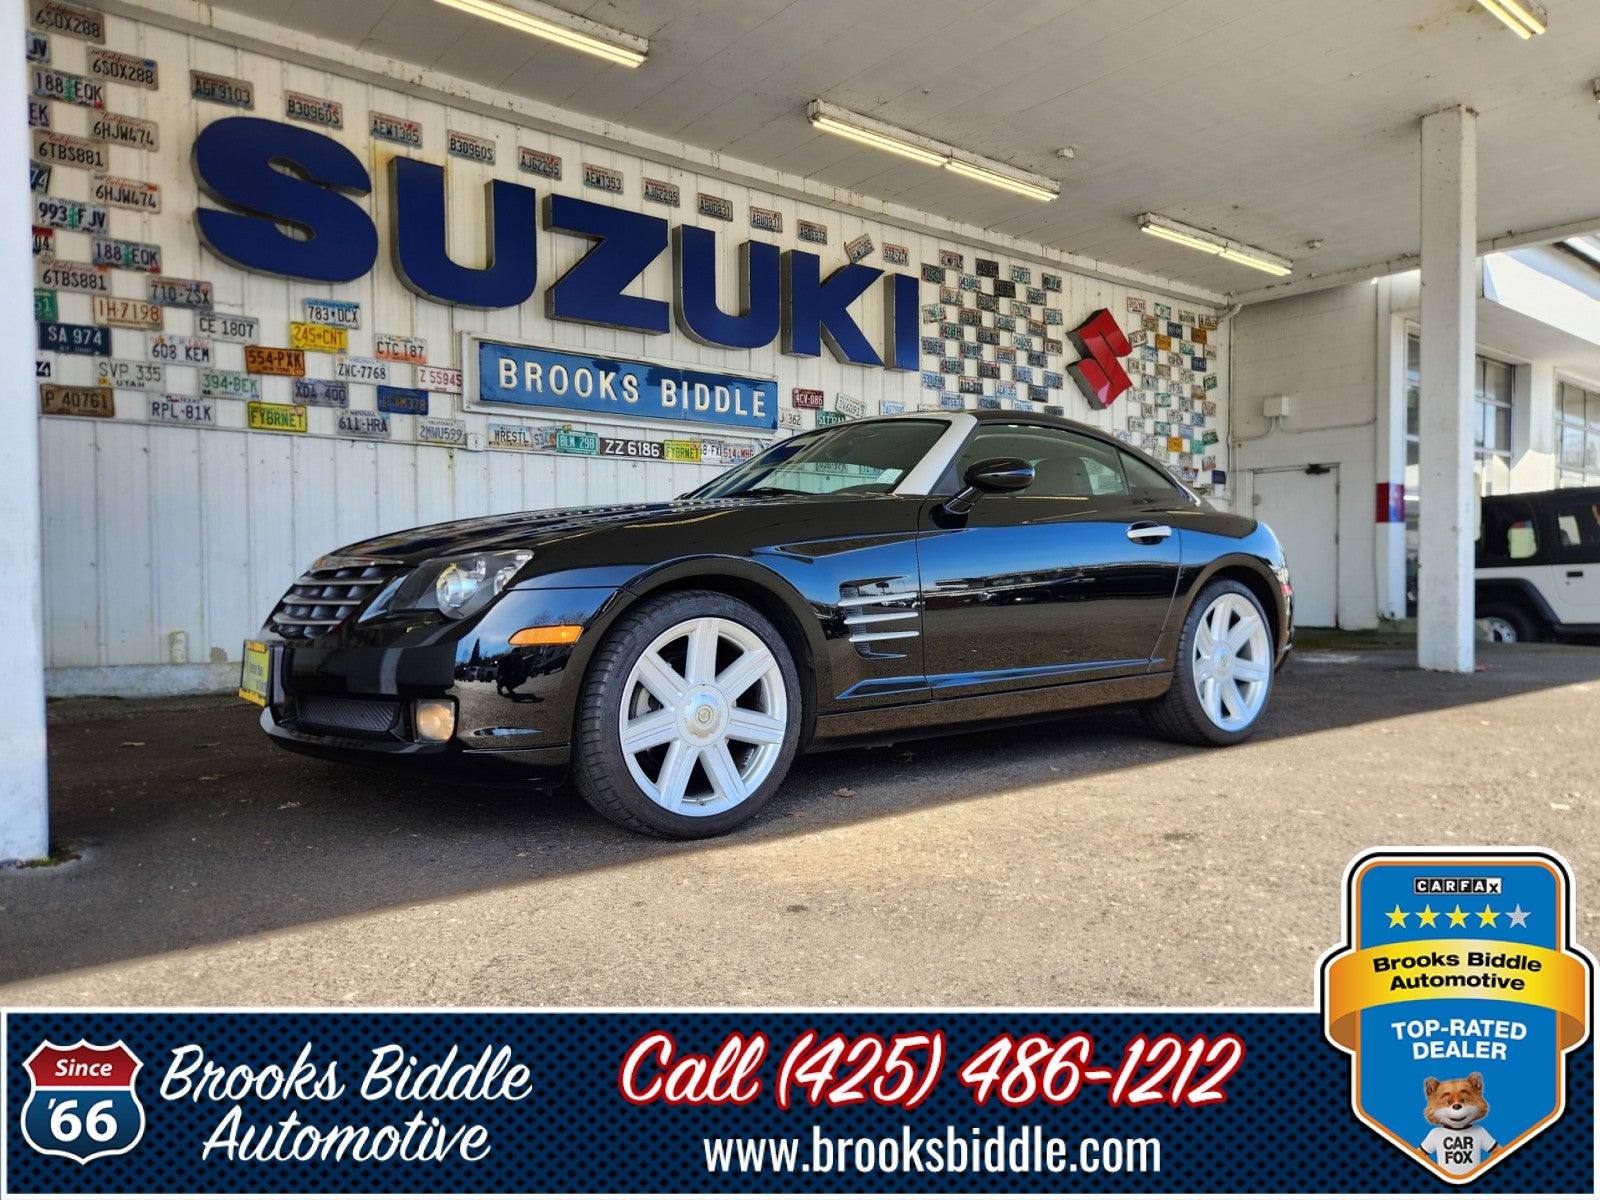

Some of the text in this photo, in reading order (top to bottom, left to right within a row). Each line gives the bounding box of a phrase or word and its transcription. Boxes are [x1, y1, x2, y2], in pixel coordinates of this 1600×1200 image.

[36, 72, 64, 94] 188
[93, 121, 154, 146] 6HJW474
[39, 142, 104, 167] 6TBS881
[96, 185, 157, 208] 6HJW474
[39, 202, 67, 222] 993
[193, 115, 919, 372] SUZUKI
[43, 269, 107, 291] 6TBS881
[48, 326, 102, 345] SA 974
[199, 317, 254, 338] CE 1807
[185, 347, 210, 363] KEM
[98, 361, 161, 382] SVP 335
[498, 358, 766, 418] BROOKS BIDDLE
[494, 430, 530, 444] WRESTL
[605, 439, 660, 457] ZZ 6186
